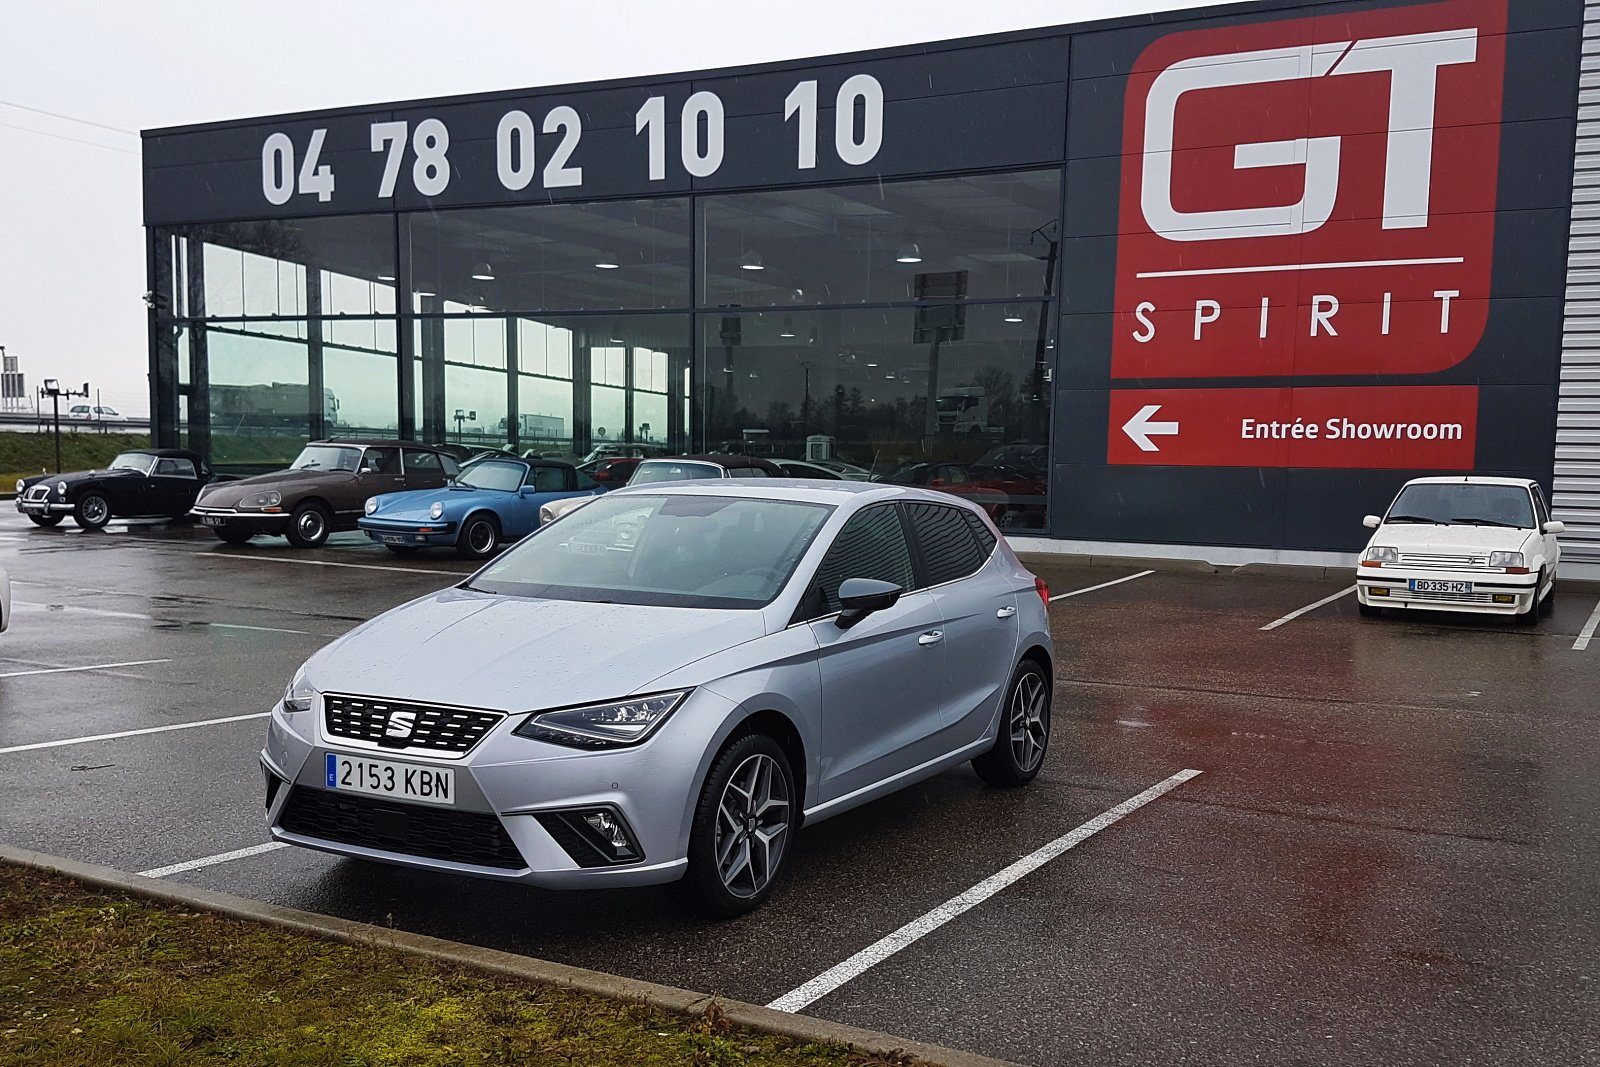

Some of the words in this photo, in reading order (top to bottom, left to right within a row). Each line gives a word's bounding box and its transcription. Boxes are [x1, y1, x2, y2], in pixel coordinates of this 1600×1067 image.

[262, 128, 335, 205] 04
[370, 118, 450, 198] 78
[496, 105, 583, 191] 02
[635, 91, 724, 181] 10
[784, 73, 884, 170] 10
[1140, 28, 1478, 242] GT
[1132, 290, 1459, 343] SPIRIT
[1241, 416, 1319, 439] Entrée
[1325, 417, 1463, 440] Showroom
[340, 760, 396, 792] 2153
[404, 767, 449, 799] KBN
